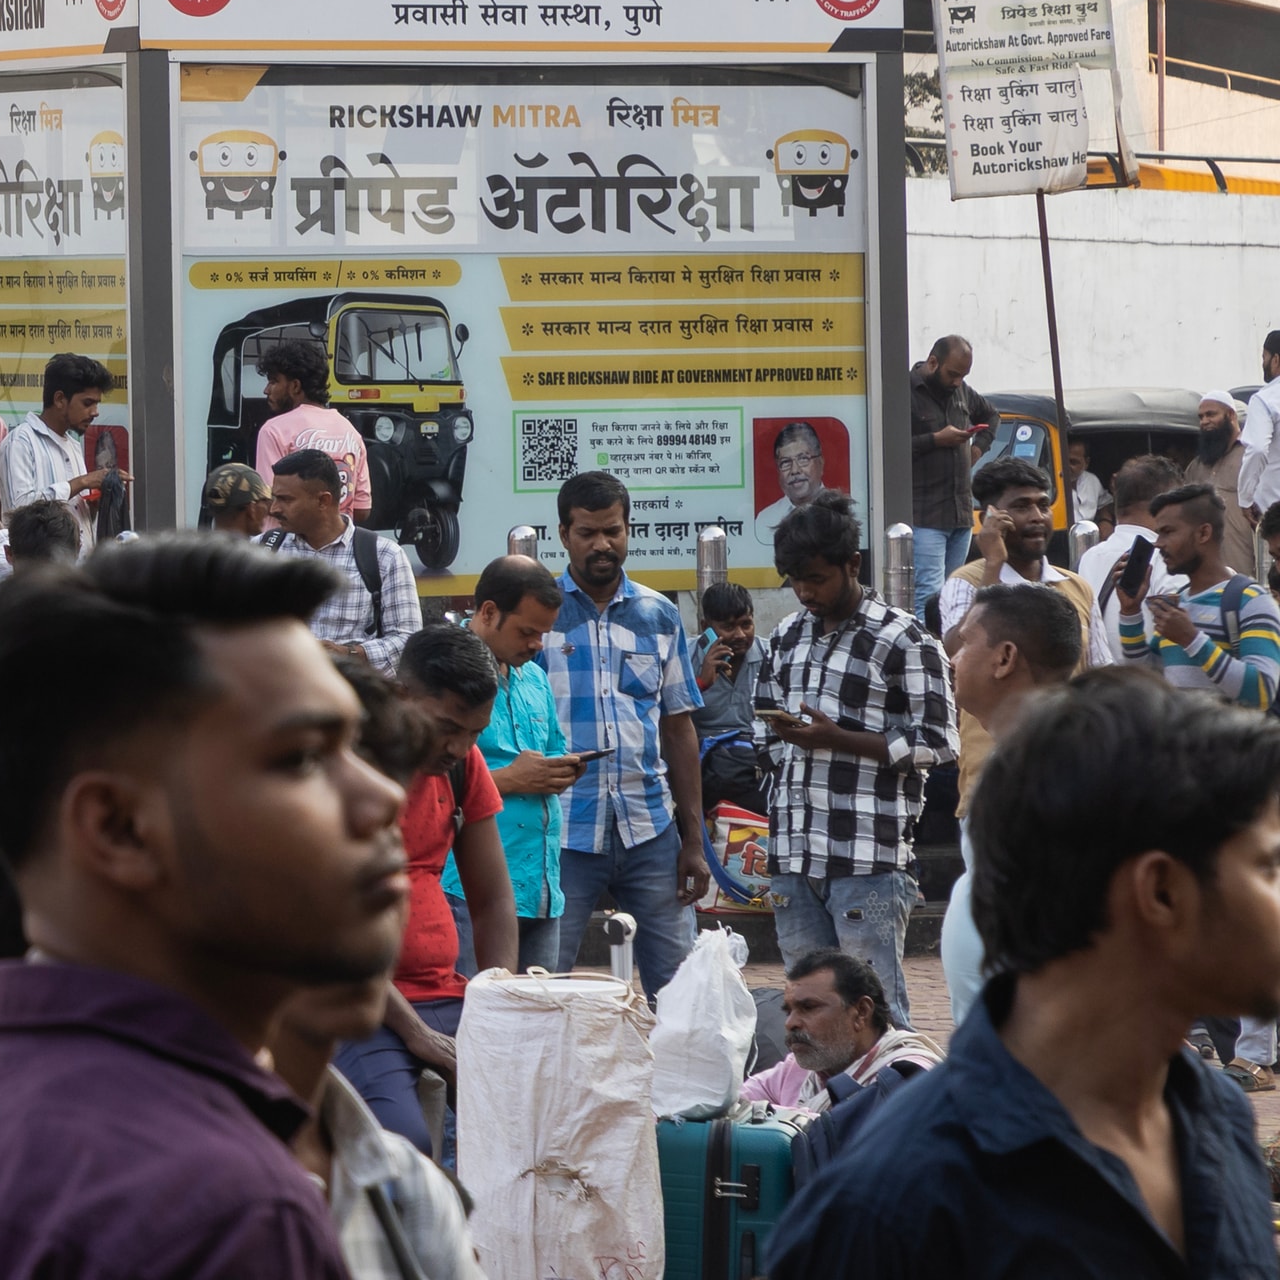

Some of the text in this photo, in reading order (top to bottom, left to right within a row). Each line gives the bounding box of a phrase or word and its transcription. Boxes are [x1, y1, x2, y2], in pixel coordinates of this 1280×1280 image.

[824, 1, 840, 15] CITY
[840, 5, 868, 18] TRAFFIC
[945, 28, 1111, 53] Autorickshaw At Govt. Approved Fare
[971, 49, 1097, 67] No Commission No Fraud
[960, 80, 1076, 104] रिक्षा बुकिंग चालु
[329, 105, 582, 129] RICKSHAW MITRA
[607, 95, 721, 131] रिक्षा मित्र
[963, 108, 1079, 133] रिक्षा बुकिंग चालु
[970, 140, 1043, 157] Book Your
[972, 155, 1069, 176] Autorickshaw
[290, 153, 458, 235] प्रीपेड
[384, 266, 427, 280] कमिशन
[539, 265, 822, 289] सरकार मान्य किराया मे सुरक्षित रिक्षा प्रवास
[538, 367, 843, 386] SAFE RICKSHAW RIDE AT GOVERNMENT APPROVED RATE
[656, 433, 717, 446] 89994 48149
